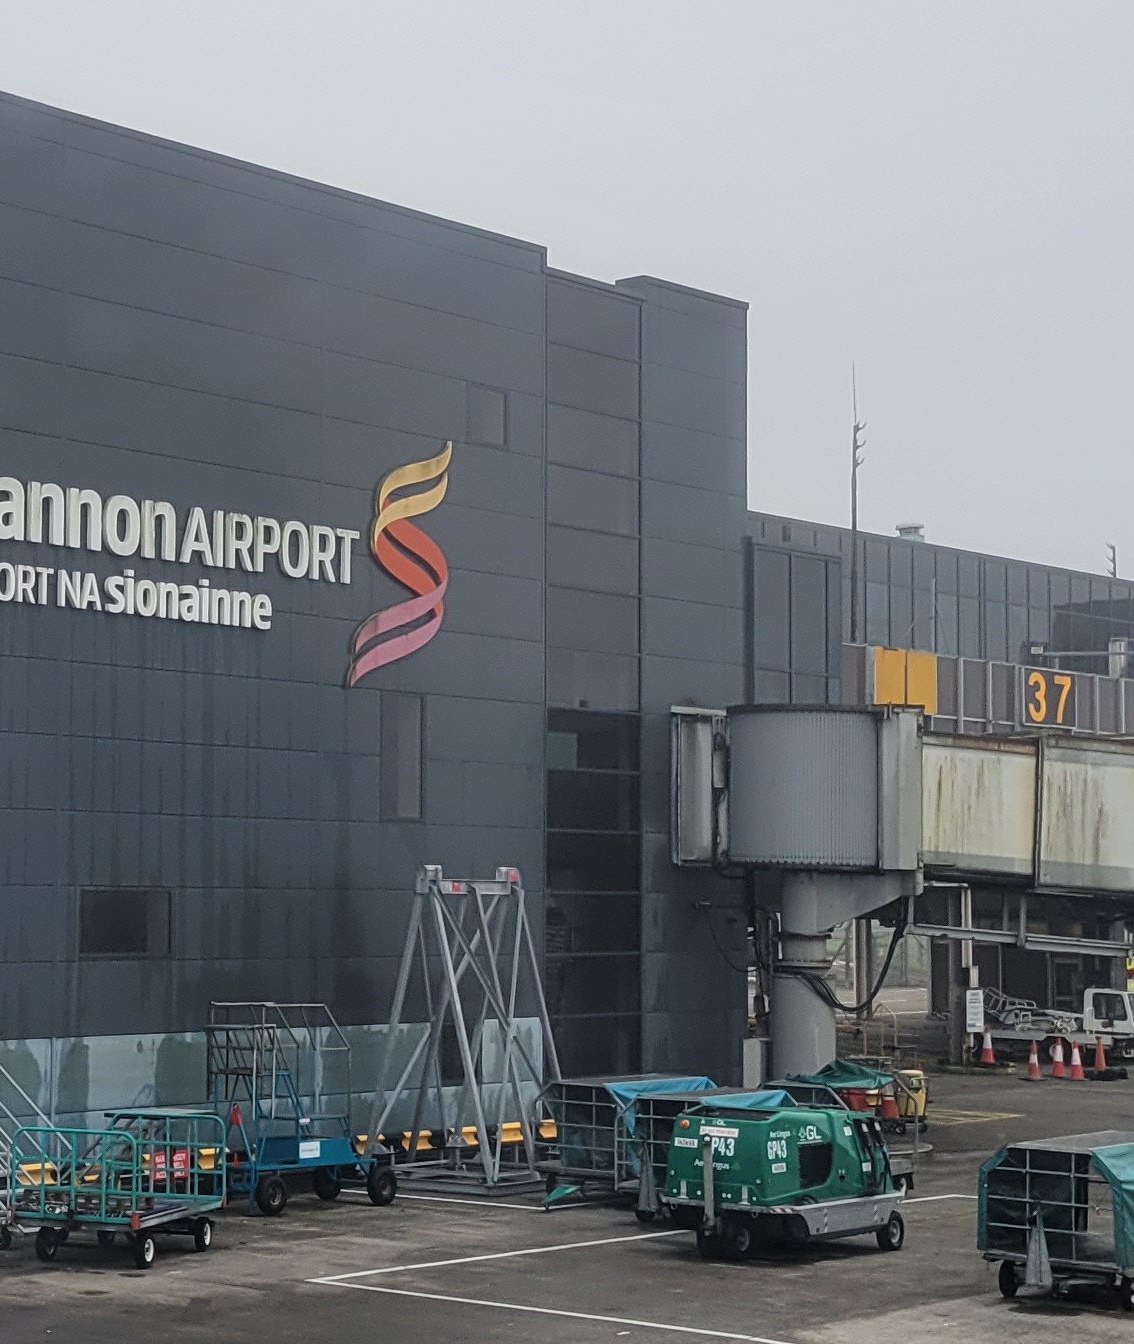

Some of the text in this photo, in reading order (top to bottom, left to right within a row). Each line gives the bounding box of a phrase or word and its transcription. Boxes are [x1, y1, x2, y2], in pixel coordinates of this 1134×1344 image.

[179, 506, 361, 584] AIRPORT
[57, 569, 102, 612] NA
[104, 569, 273, 630] sionainne
[1027, 671, 1072, 724] 37
[767, 1139, 787, 1160] GP43
[806, 1125, 823, 1140] GL
